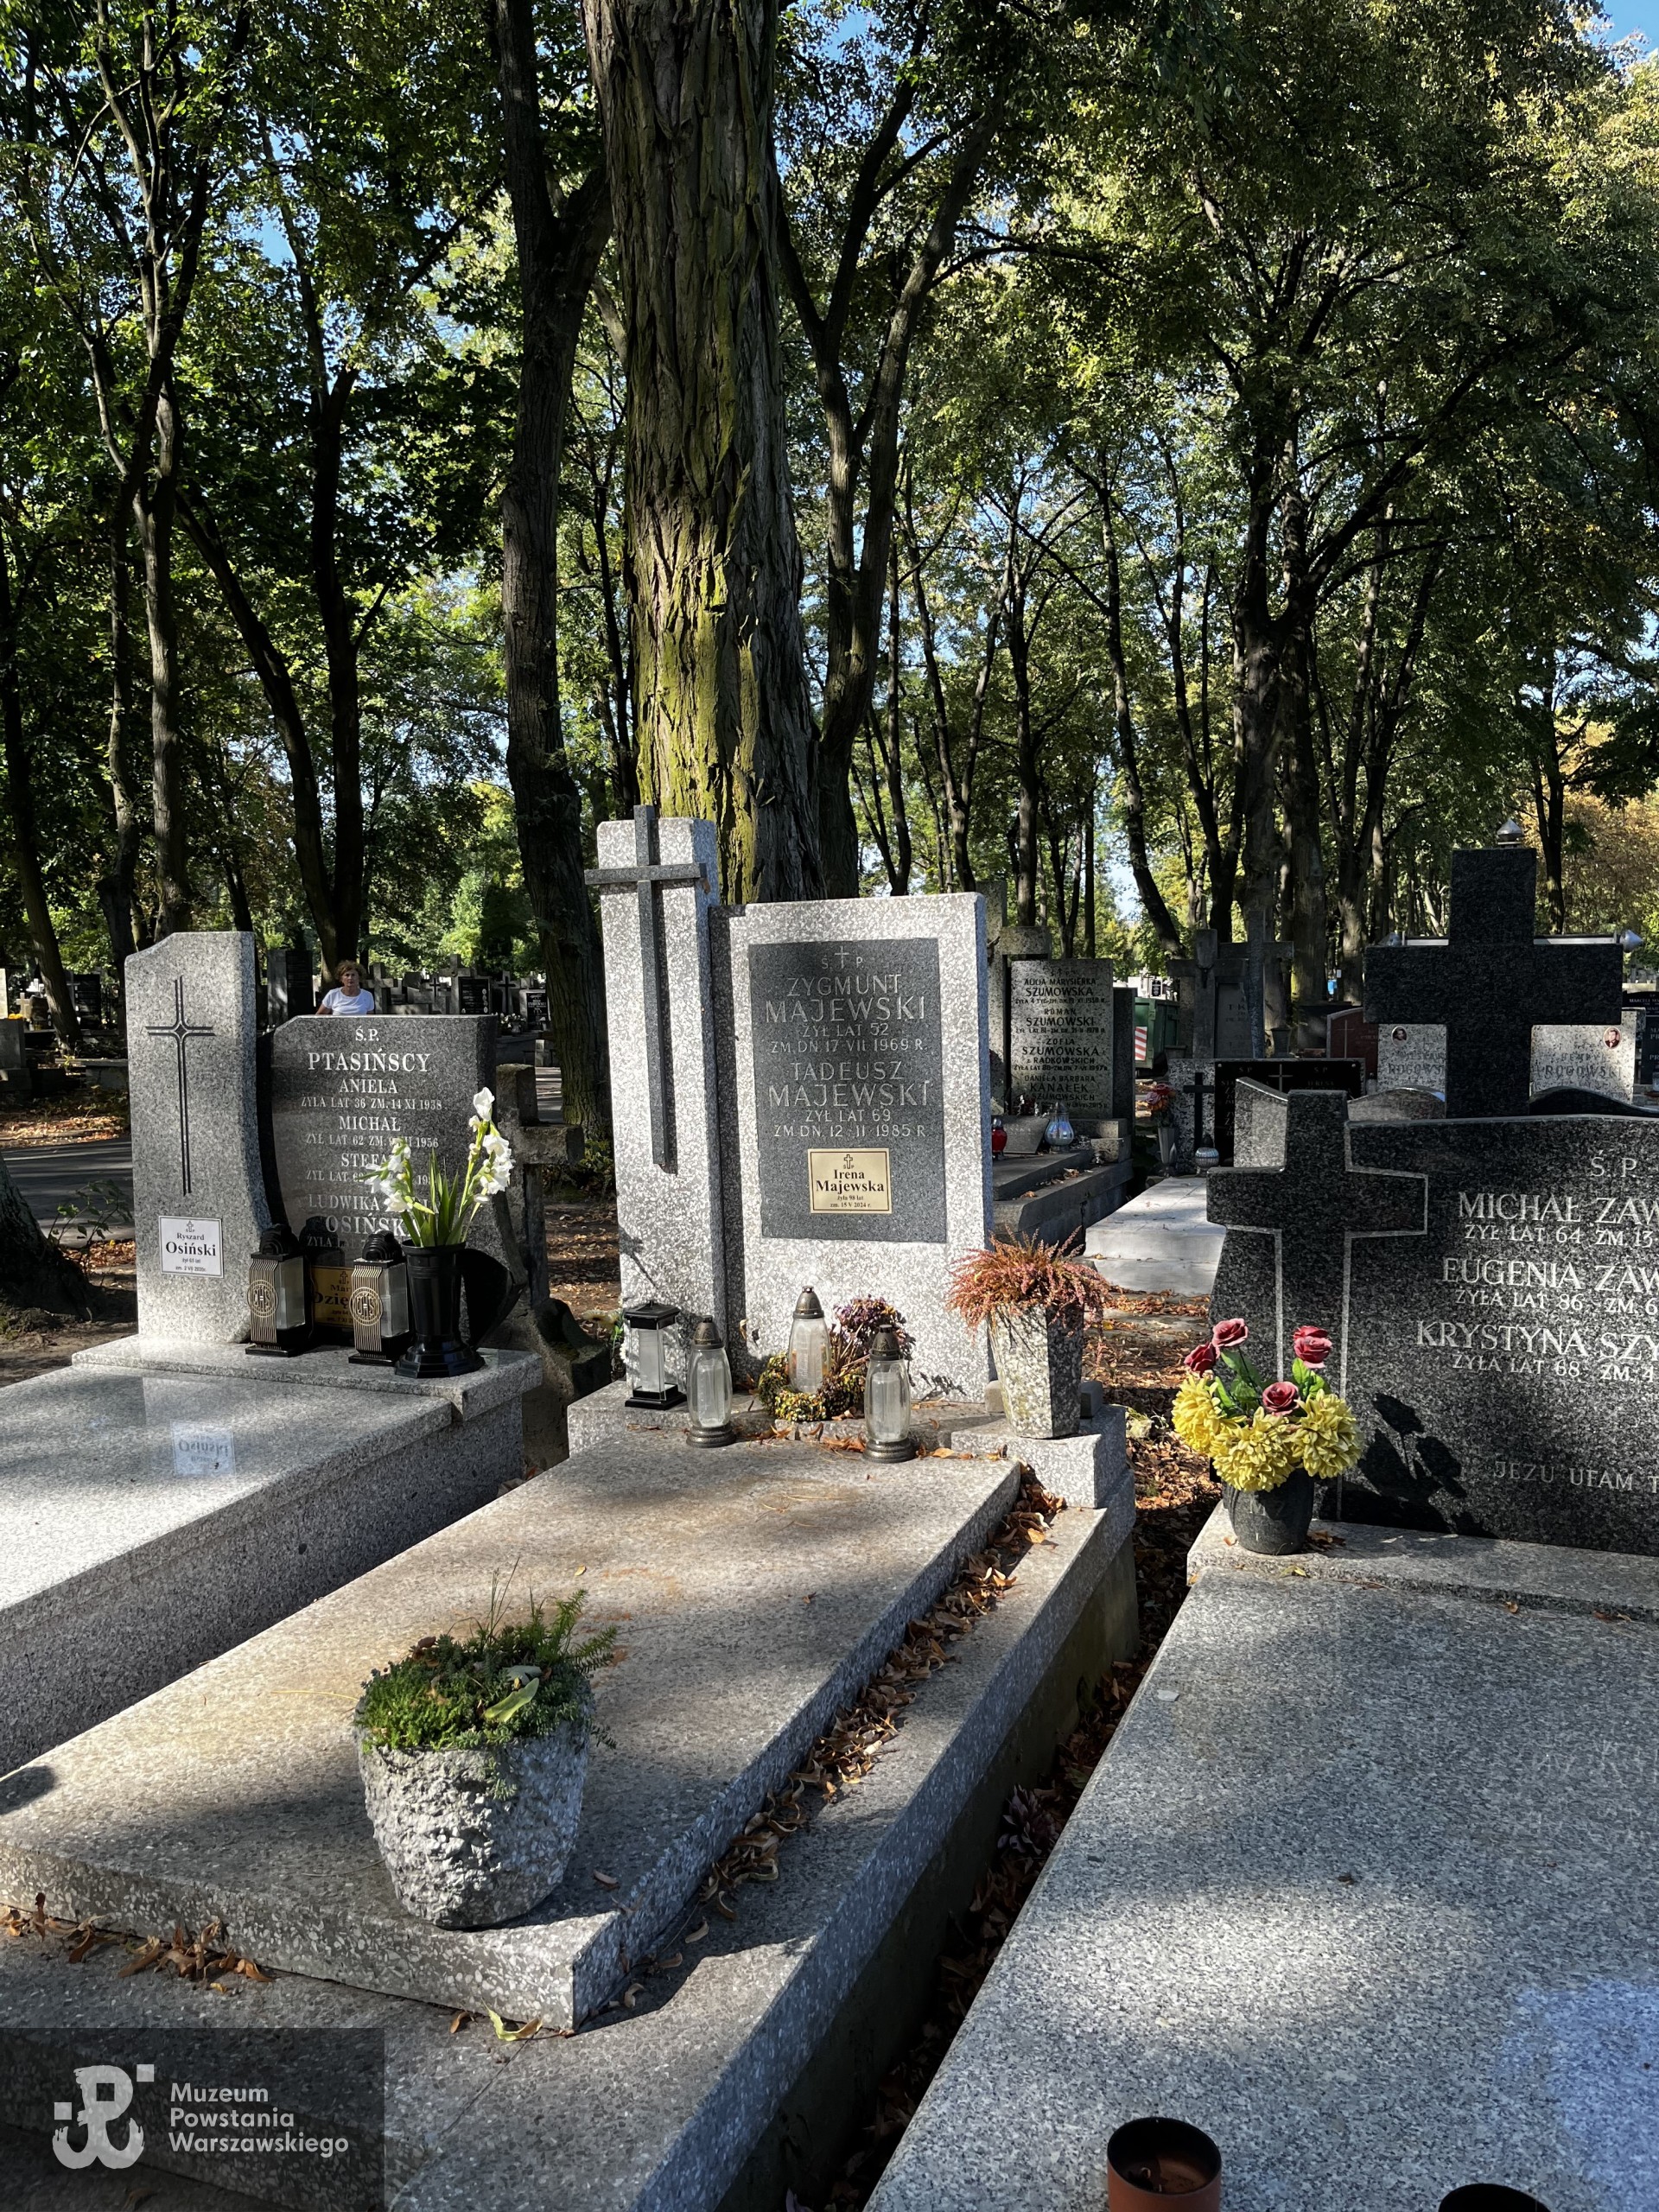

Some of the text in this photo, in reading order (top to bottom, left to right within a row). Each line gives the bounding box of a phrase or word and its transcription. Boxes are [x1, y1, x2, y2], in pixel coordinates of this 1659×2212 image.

[787, 974, 901, 996] ZYGMUNT
[1027, 987, 1093, 997] SZUMOWSKA
[766, 995, 925, 1023] MAJEWSKI
[837, 1023, 862, 1036] LAT
[870, 1022, 889, 1036] 52
[1027, 1017, 1095, 1027] SZUMOWSKI
[874, 1039, 909, 1051] 1969
[1022, 1046, 1100, 1056] SZUMOWSKA
[308, 1047, 431, 1073] PTASIŃSCY
[790, 1061, 905, 1081] TADEUSZ
[339, 1079, 398, 1094] ANIELA
[768, 1081, 931, 1107] MAJEWSKI
[331, 1098, 350, 1109] LAT
[354, 1098, 366, 1109] 36
[419, 1099, 442, 1111] 1938
[839, 1109, 864, 1122] LAT
[872, 1109, 891, 1122] 69
[339, 1116, 401, 1132] MICHAŁ
[876, 1124, 910, 1137] 1985
[329, 1133, 348, 1146] LAT
[353, 1135, 364, 1146] 62
[416, 1136, 439, 1149] 1956
[341, 1153, 394, 1167] STEFA
[329, 1170, 347, 1183] LAT
[834, 1169, 865, 1179] Irena
[816, 1180, 884, 1194] Majewska
[308, 1193, 380, 1211] LUDWIKA
[1458, 1191, 1580, 1222] MICHAŁ
[325, 1212, 410, 1236] OSIŃSK
[176, 1232, 205, 1241] Ryszard
[1511, 1226, 1545, 1242] LAT
[1555, 1226, 1580, 1244] 64
[166, 1241, 216, 1256] Osiński
[1442, 1257, 1585, 1290] EUGENIA
[1514, 1293, 1547, 1308] LAT
[1559, 1294, 1583, 1311] 86
[1416, 1320, 1589, 1357] KRYSTYNA
[1511, 1357, 1545, 1375] LAT
[1555, 1359, 1580, 1377] 68
[1493, 1460, 1555, 1484] JEZU
[1568, 1468, 1634, 1491] UFAM
